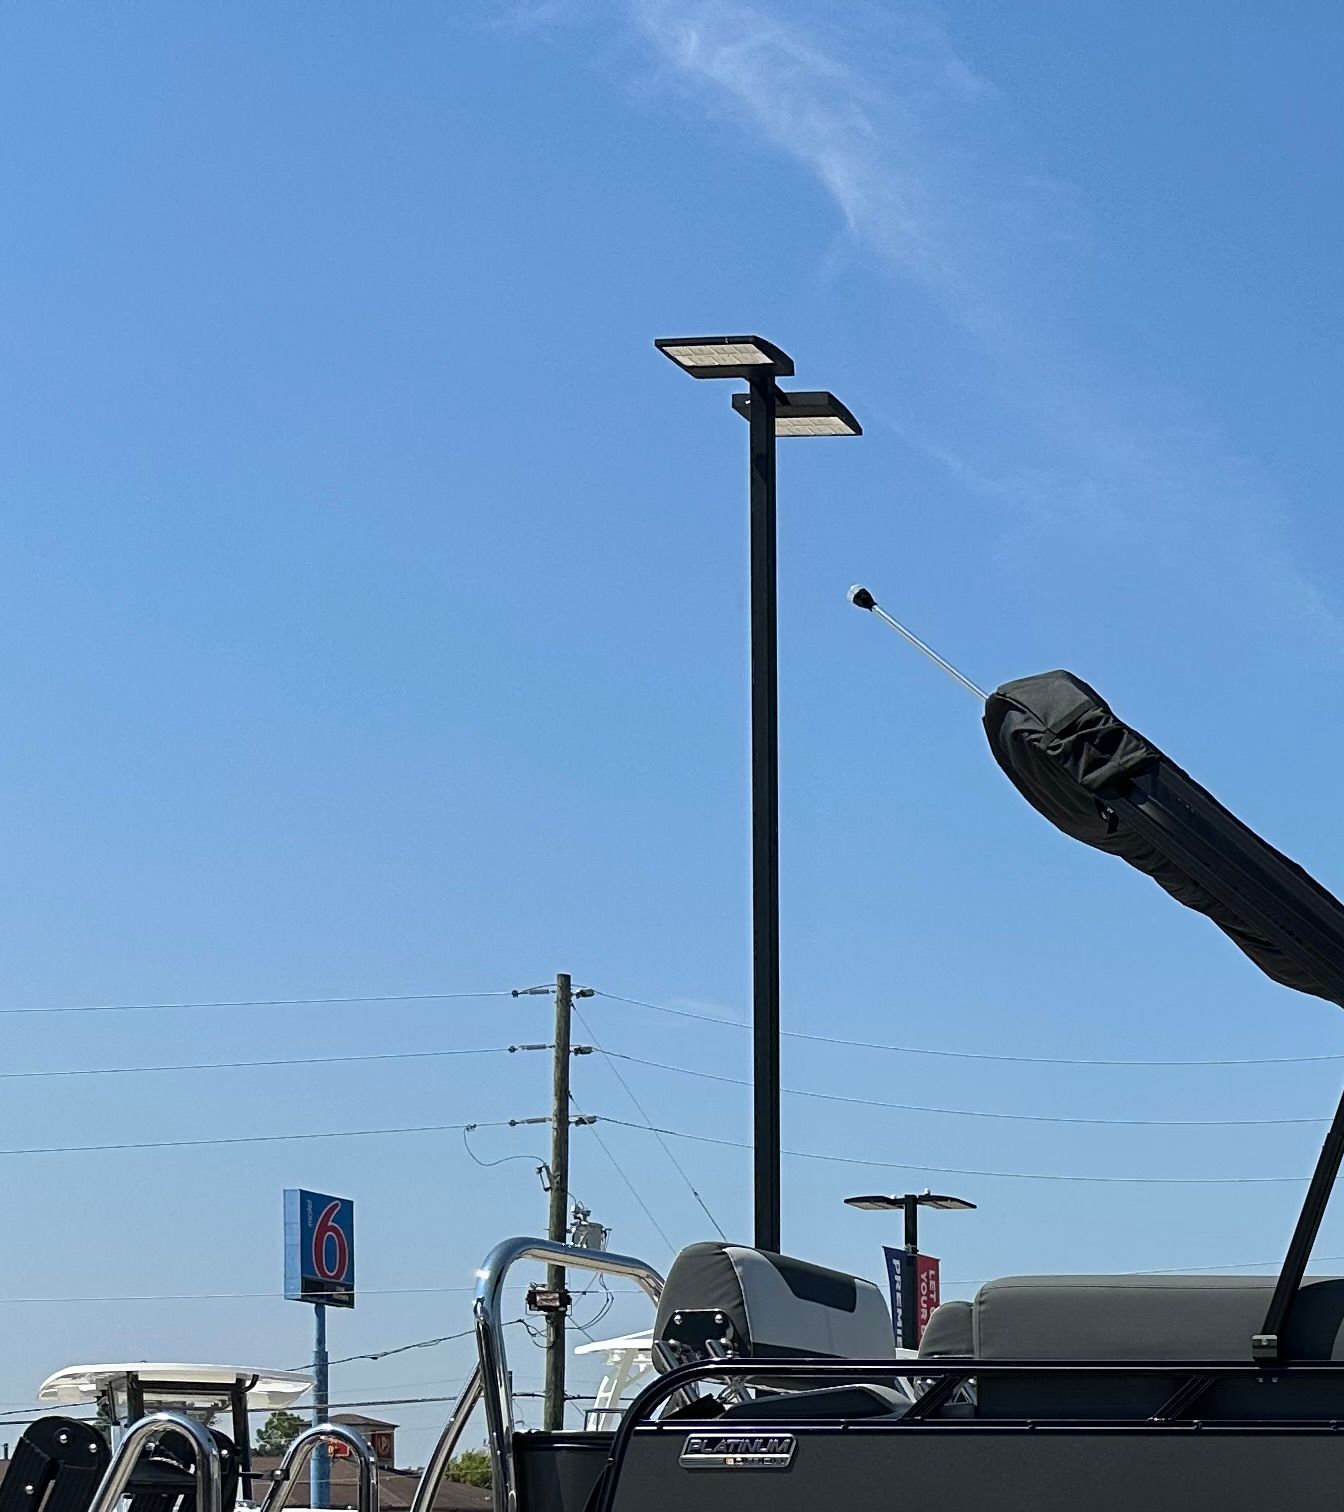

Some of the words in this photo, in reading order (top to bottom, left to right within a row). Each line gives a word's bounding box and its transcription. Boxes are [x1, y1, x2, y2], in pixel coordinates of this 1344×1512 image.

[312, 1200, 348, 1281] 6
[892, 1258, 902, 1348] PREMIE
[928, 1269, 936, 1302] LET
[687, 1438, 791, 1453] PLATINUM
